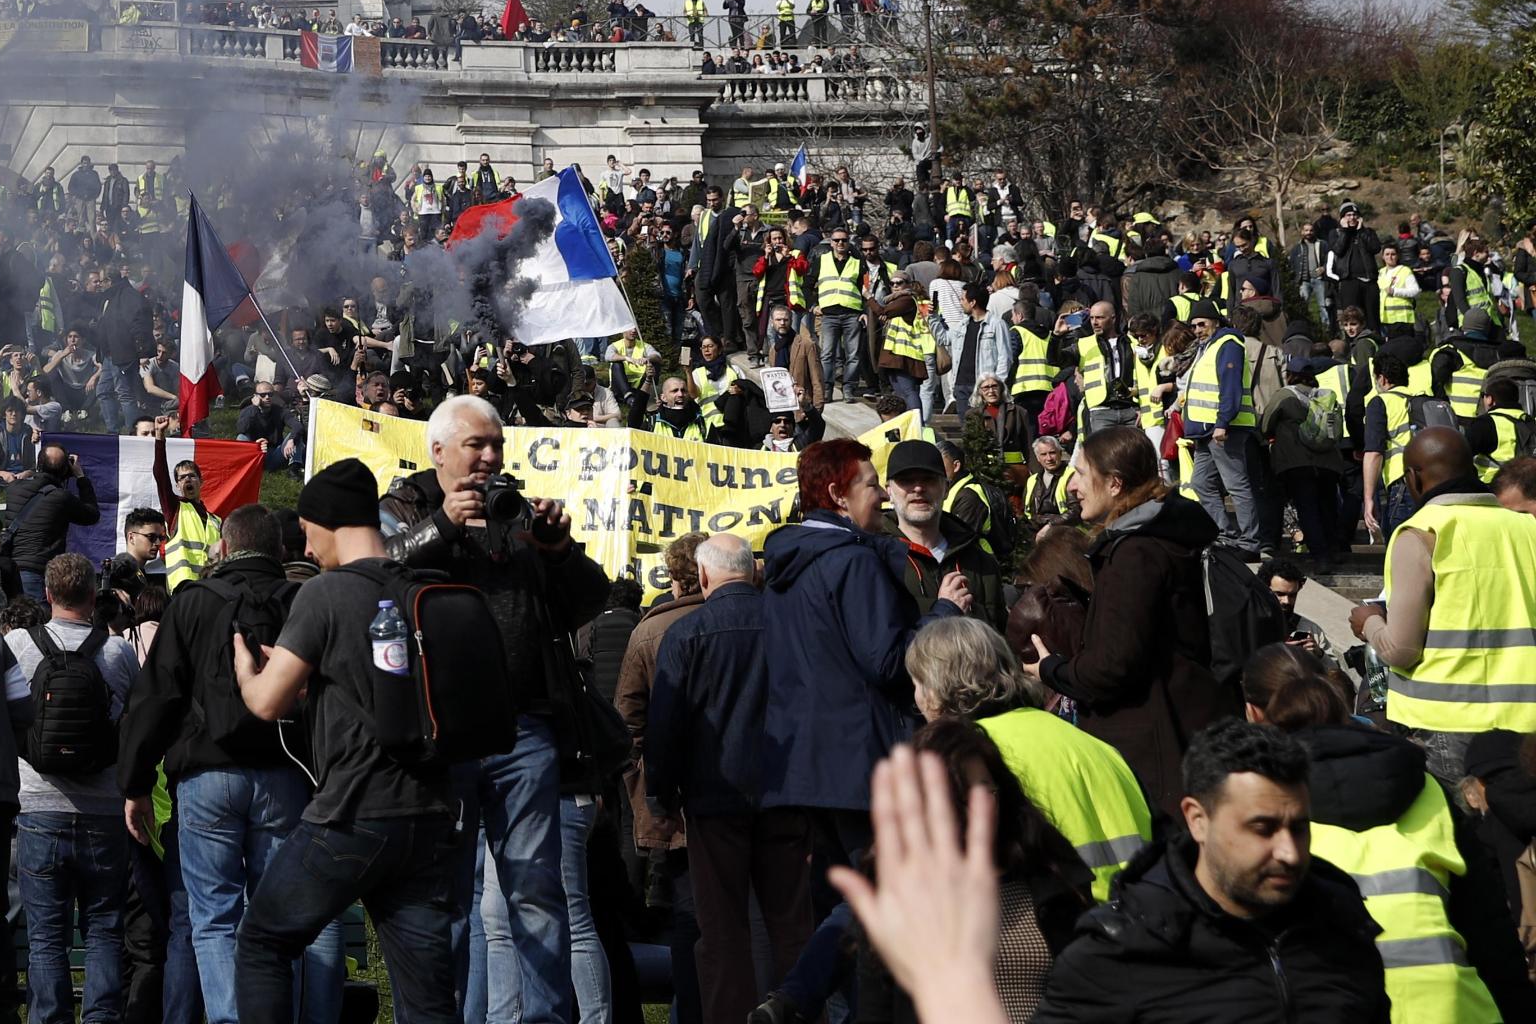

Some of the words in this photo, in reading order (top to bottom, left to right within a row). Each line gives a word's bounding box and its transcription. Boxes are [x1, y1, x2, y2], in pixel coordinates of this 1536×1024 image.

[4, 22, 16, 30] LA
[578, 446, 694, 482] pour
[707, 461, 799, 490] une
